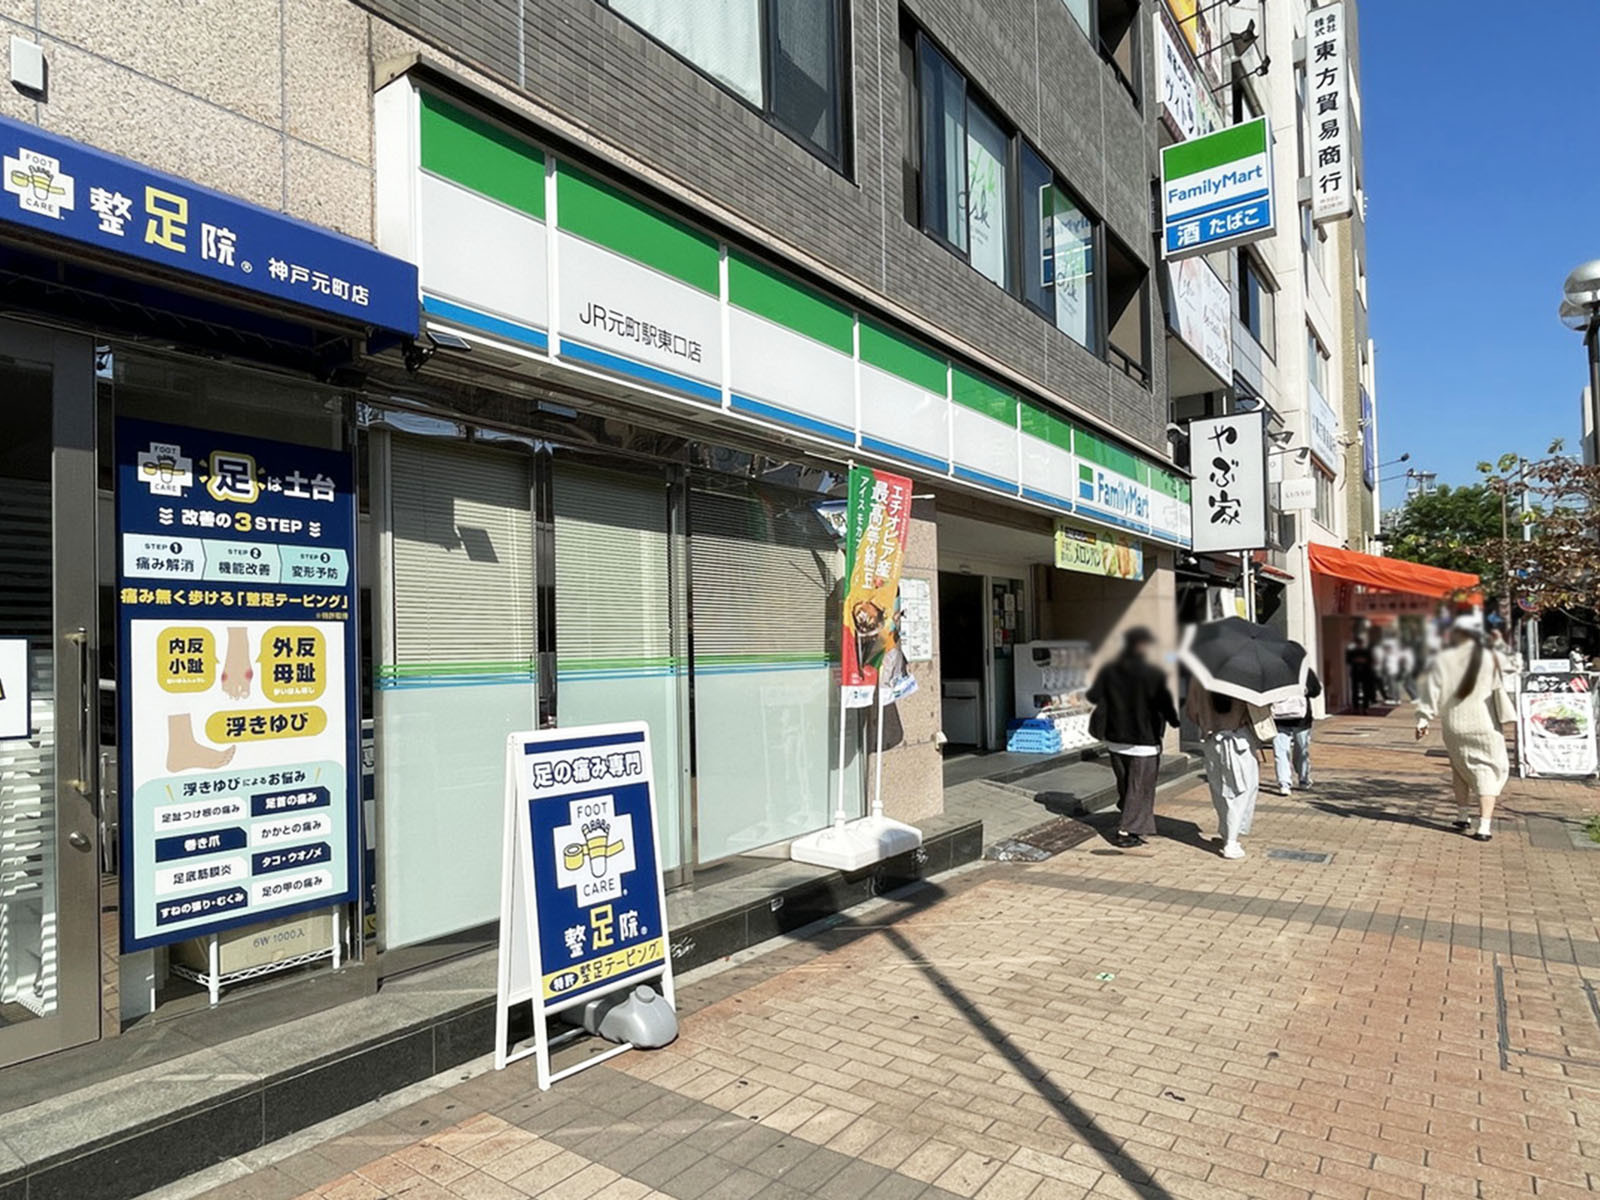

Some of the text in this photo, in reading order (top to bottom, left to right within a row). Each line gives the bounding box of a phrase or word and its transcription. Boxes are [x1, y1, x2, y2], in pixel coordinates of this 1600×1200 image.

[1314, 13, 1337, 37] 株式会社
[1314, 38, 1342, 195] 東方貿易商行
[25, 153, 53, 168] FOOT
[1168, 165, 1262, 203] FamilyMart
[26, 198, 54, 213] CARE
[1177, 207, 1260, 246] 酒 たばこ
[268, 257, 370, 307] 神戸元町店
[580, 302, 702, 363] JR元町駅東口店
[154, 445, 177, 455] FOOT
[212, 454, 336, 502] 足は土台
[1208, 424, 1241, 526] やぶ家
[155, 482, 177, 493] CARE
[1098, 472, 1150, 519] FamilyMart
[874, 484, 904, 579] エチオピア産
[145, 542, 168, 550] STEP
[228, 548, 248, 556] STEP
[136, 556, 194, 573] 痛み解消
[218, 561, 270, 576] 機能改善
[291, 565, 339, 580] 変形予防
[120, 587, 348, 609] 痛み無く歩ける「整足テーピング」
[169, 637, 204, 654] 内反
[273, 637, 316, 658] 外反
[169, 657, 204, 675] 小趾
[273, 662, 316, 684] 母趾
[226, 711, 309, 737] 浮きゆび
[533, 750, 643, 789] 足の痛み専門
[183, 770, 306, 796] 浮きゆびによるお悩み
[265, 790, 317, 810] 足首の痛み
[577, 802, 607, 819] FOOT
[161, 803, 241, 824] 足趾つけ根の痛み
[261, 820, 322, 839] かかとの痛み
[173, 864, 232, 885] 足底筋膜炎
[262, 876, 323, 897] 足の甲の痛み
[583, 877, 615, 898] CARE
[553, 940, 659, 991] 特許 整足テーピング
